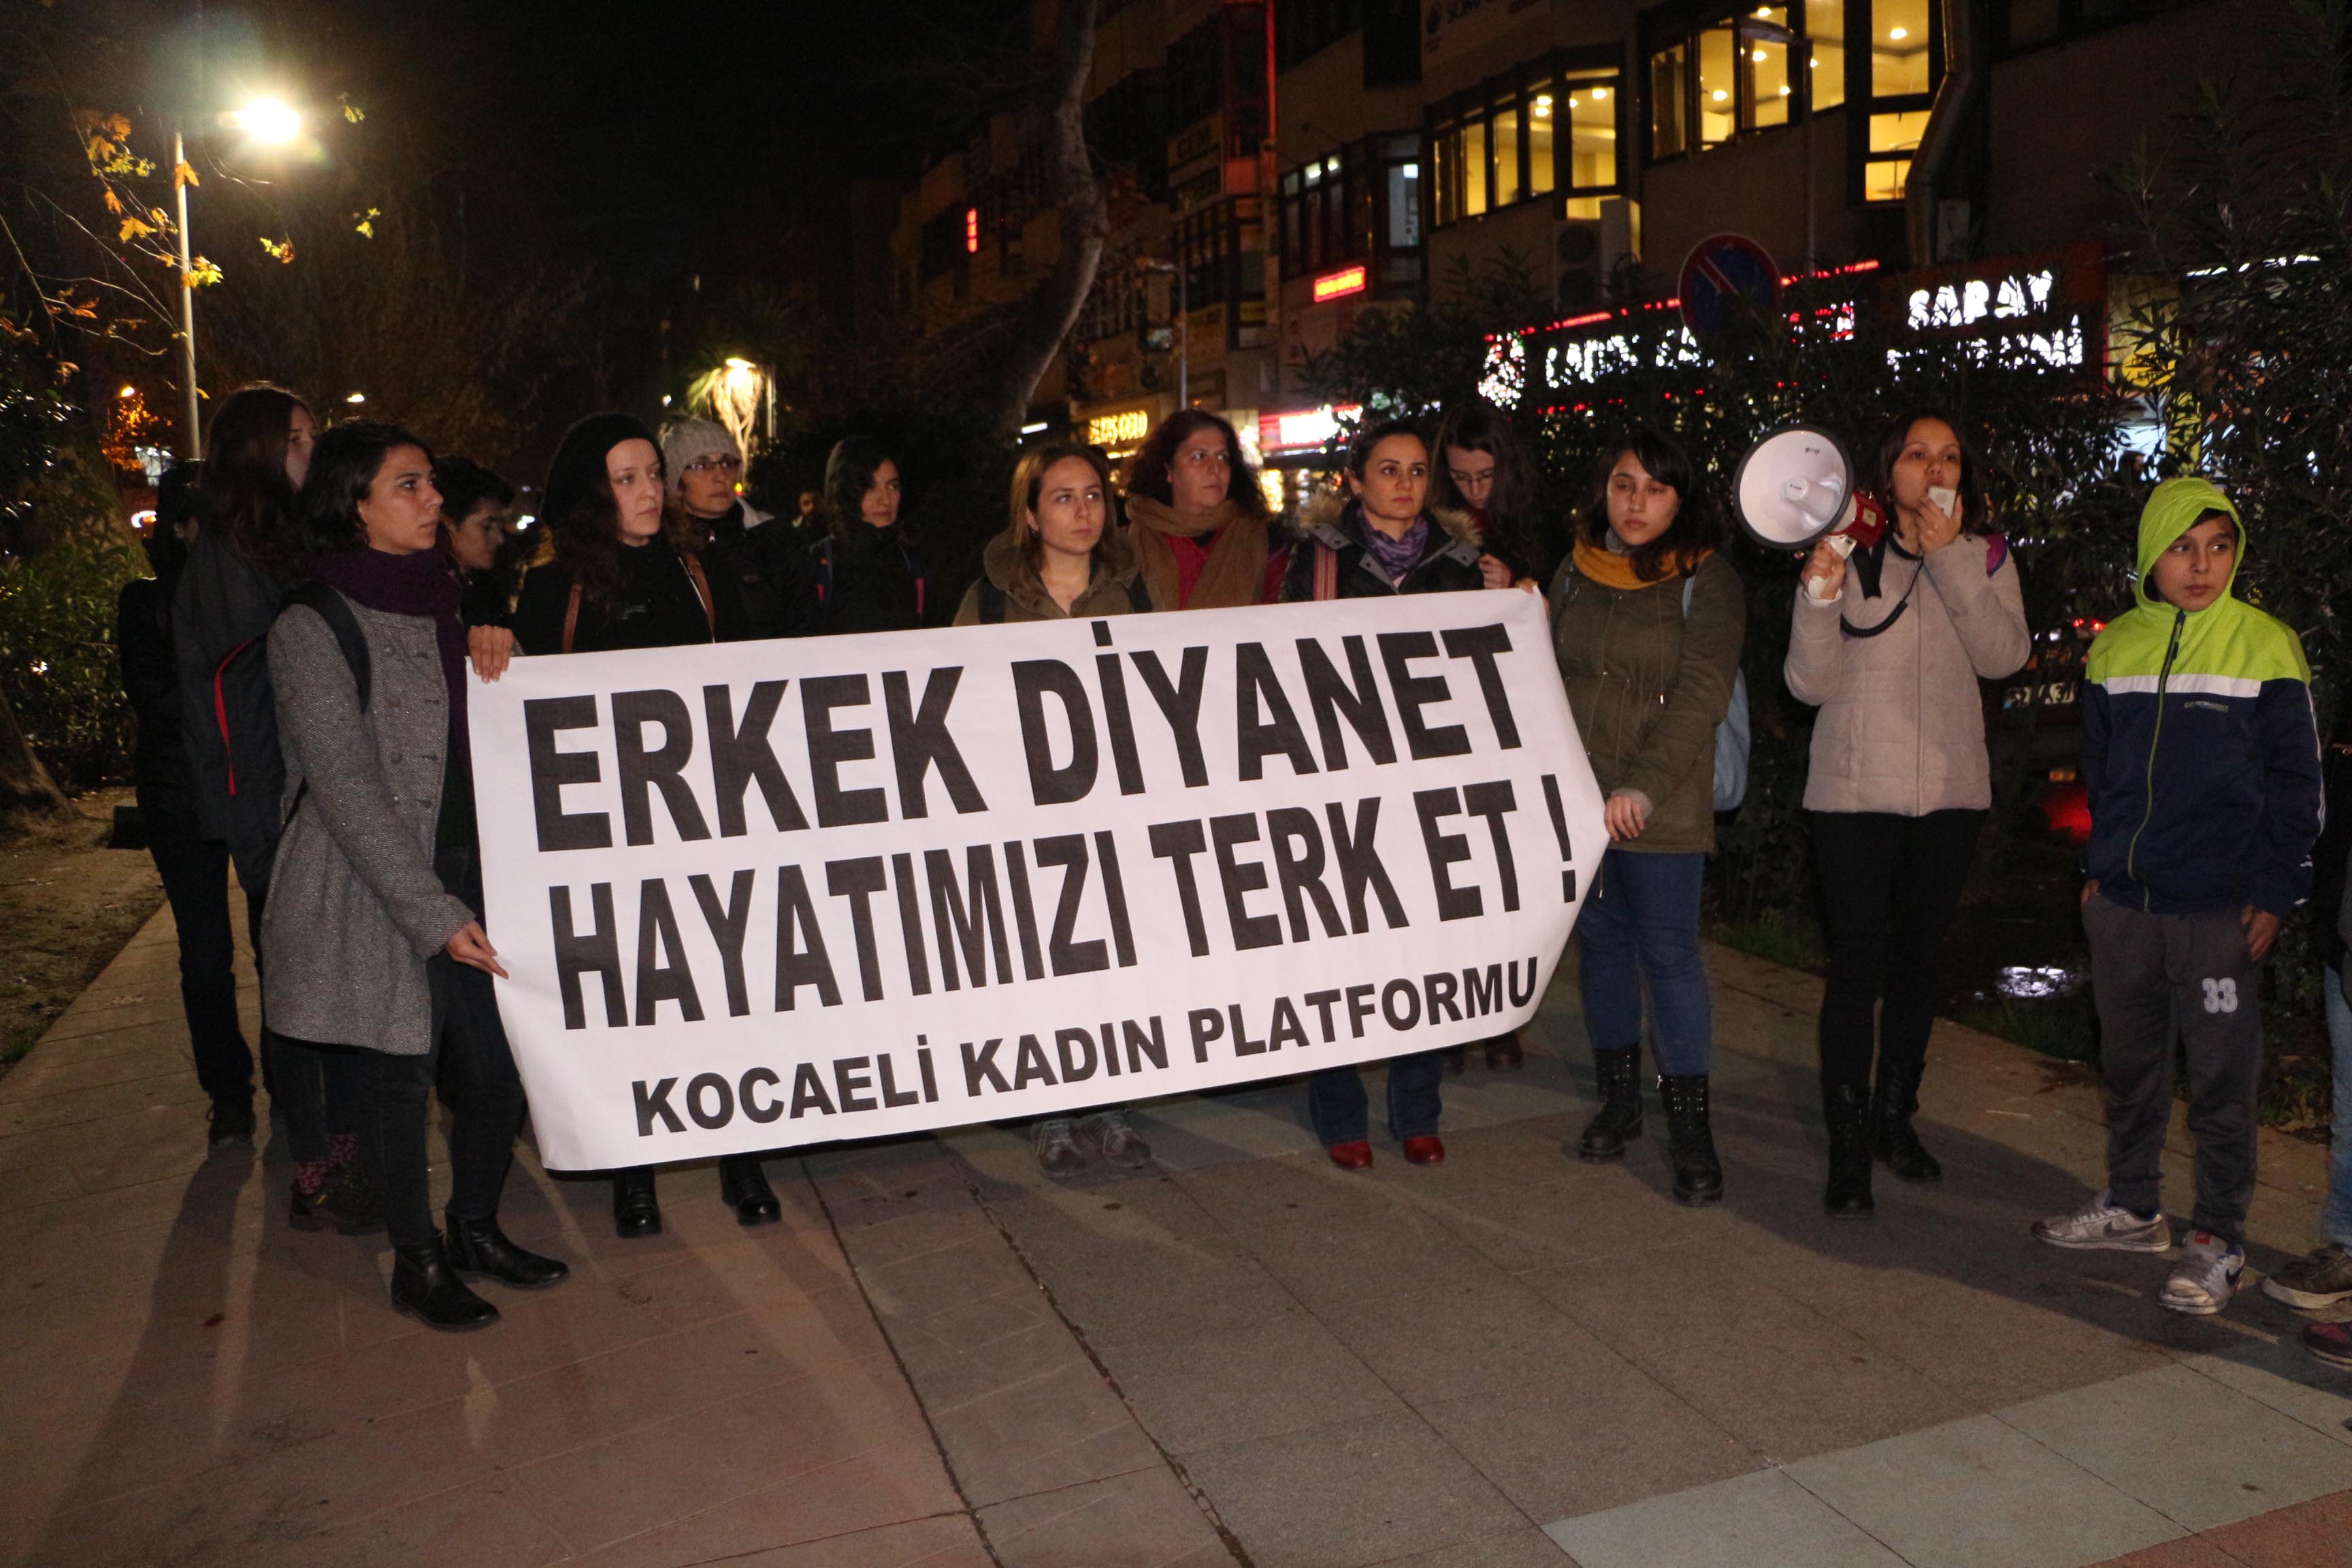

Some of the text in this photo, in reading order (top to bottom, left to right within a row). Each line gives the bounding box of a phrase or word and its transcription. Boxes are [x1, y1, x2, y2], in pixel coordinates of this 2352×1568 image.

[524, 620, 1522, 853] ERKEK DİYANET
[549, 830, 1137, 1030] HAYATIMIZI
[1147, 797, 1410, 958] TERK
[1413, 780, 1520, 922] ET
[2202, 977, 2238, 1013] 33
[632, 957, 1538, 1137] KOCAELİ KADIN PLATFORMU
